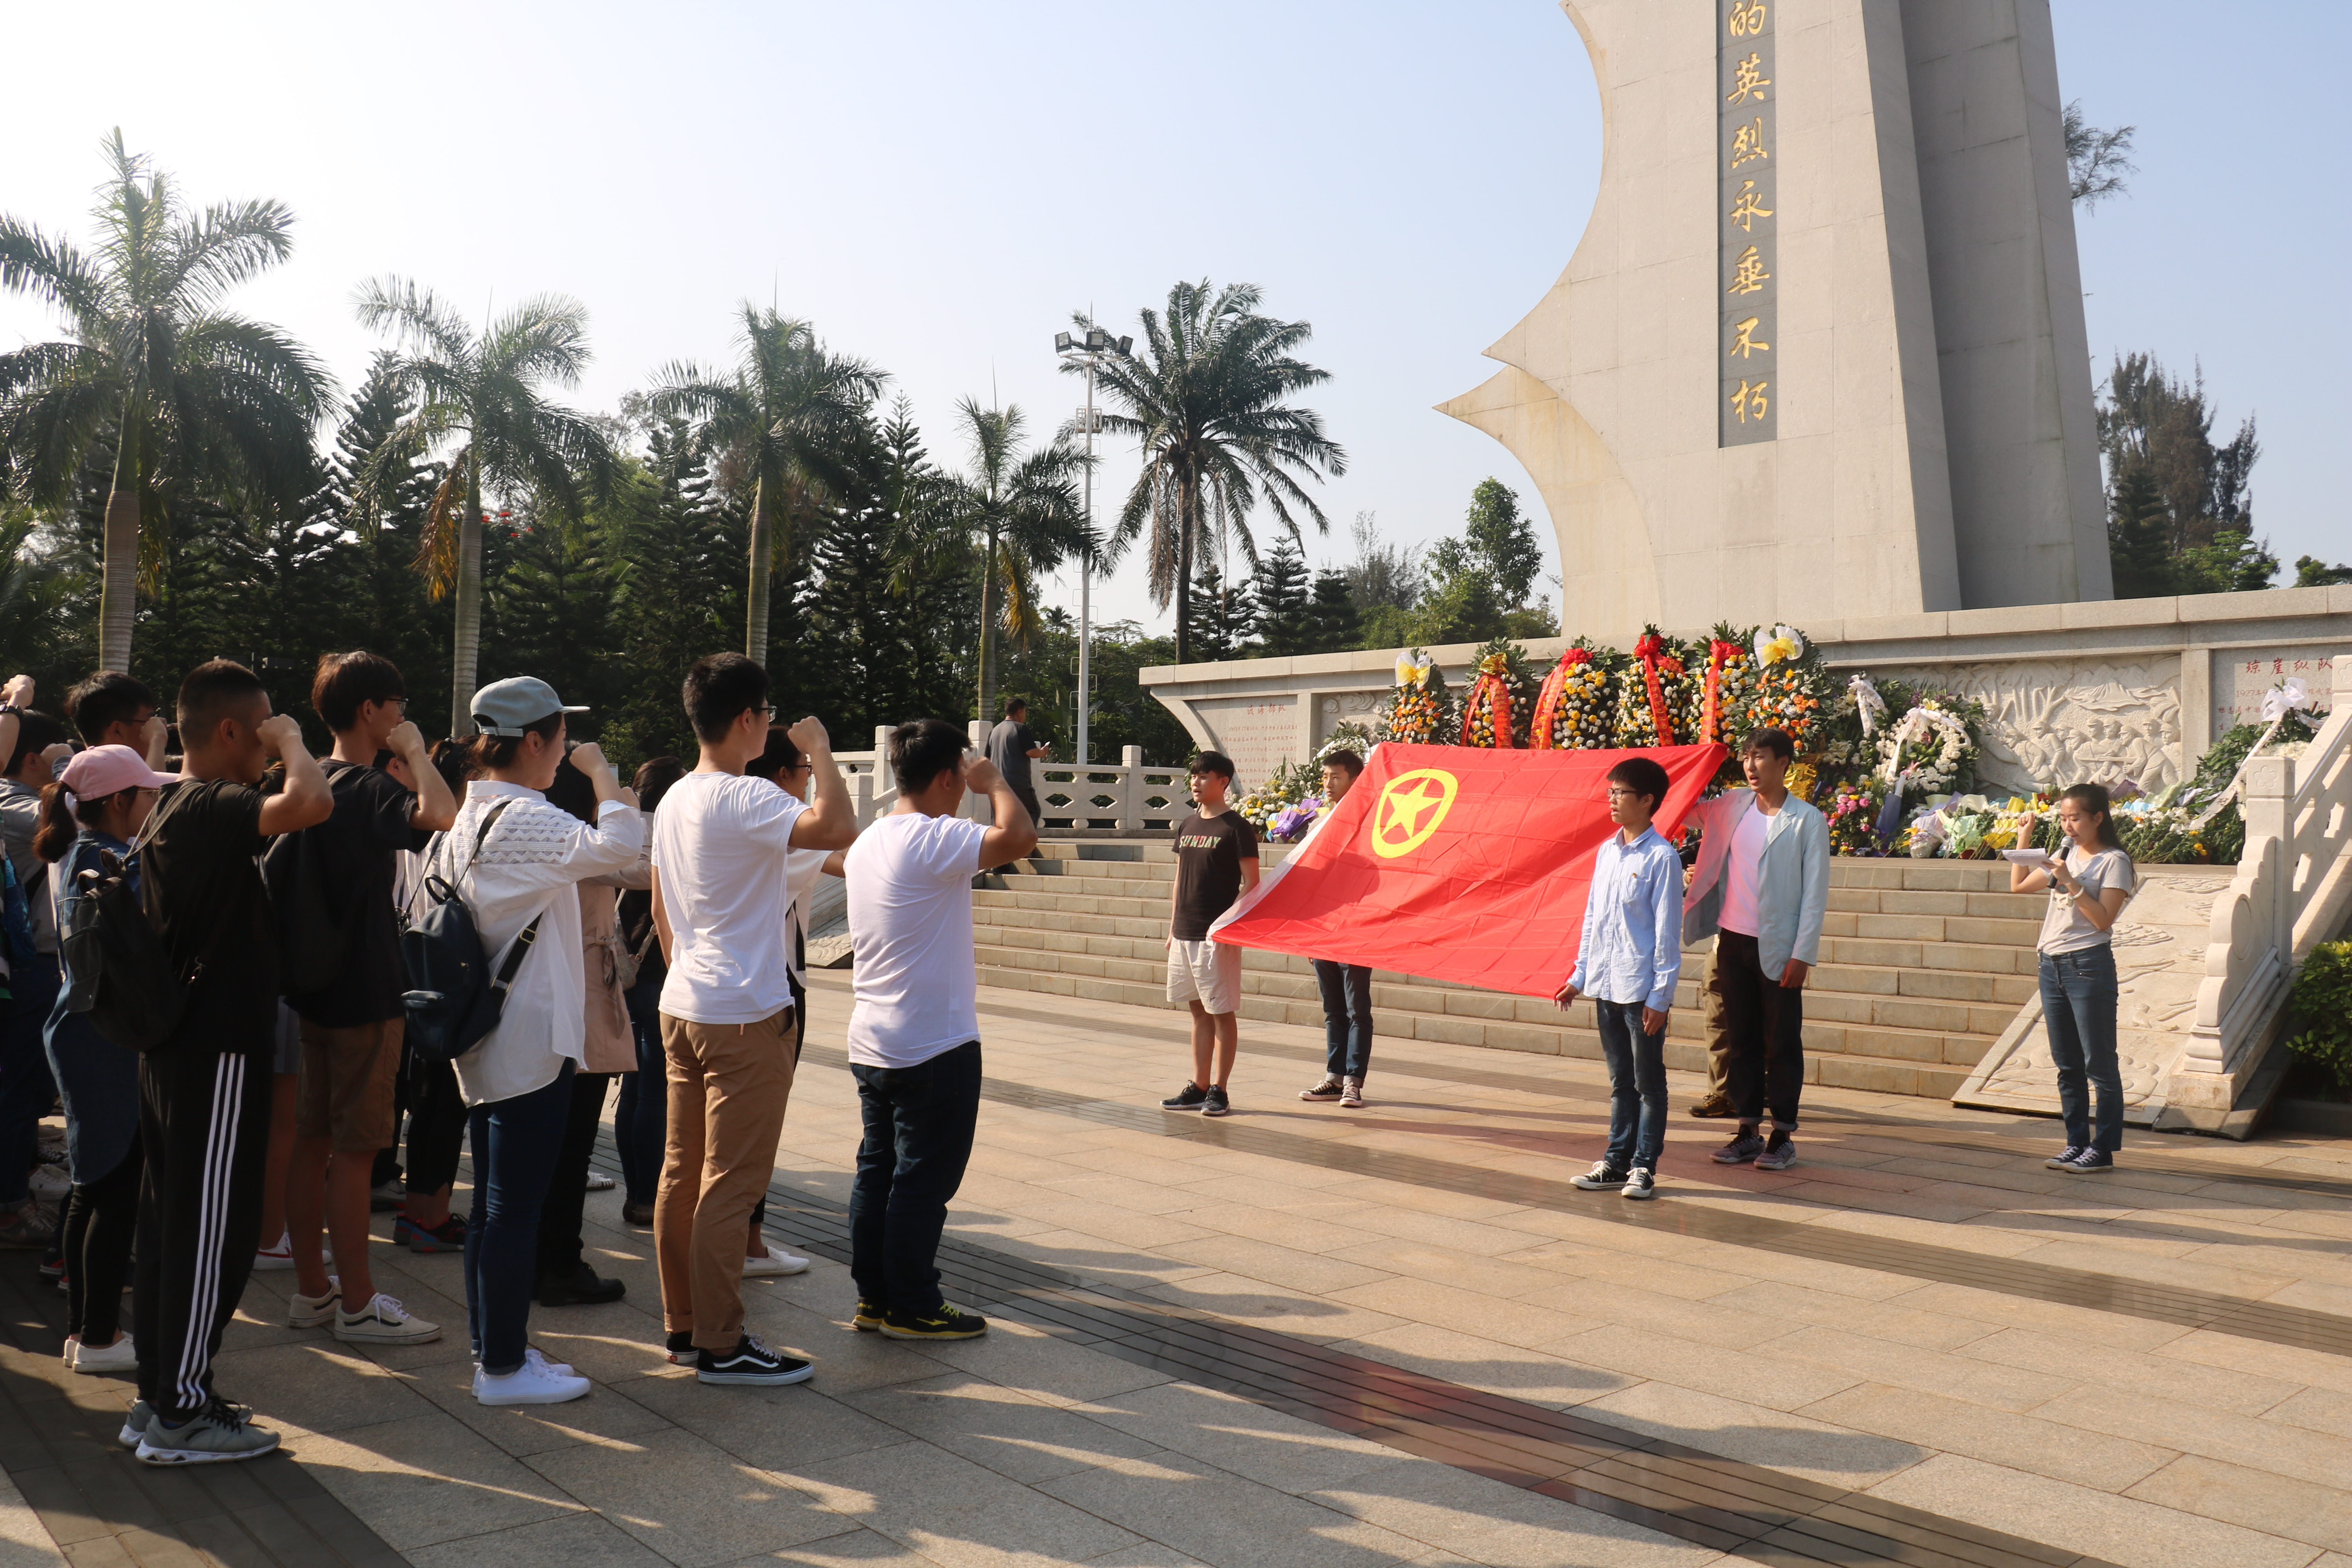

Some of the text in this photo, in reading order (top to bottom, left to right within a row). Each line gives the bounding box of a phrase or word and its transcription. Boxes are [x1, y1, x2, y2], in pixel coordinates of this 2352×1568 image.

[1726, 0, 1773, 424] 的英烈永垂不朽
[2246, 657, 2332, 676] 琼崖纵队
[1247, 703, 1287, 715] 渡海部队
[1179, 835, 1221, 849] SUNDAY
